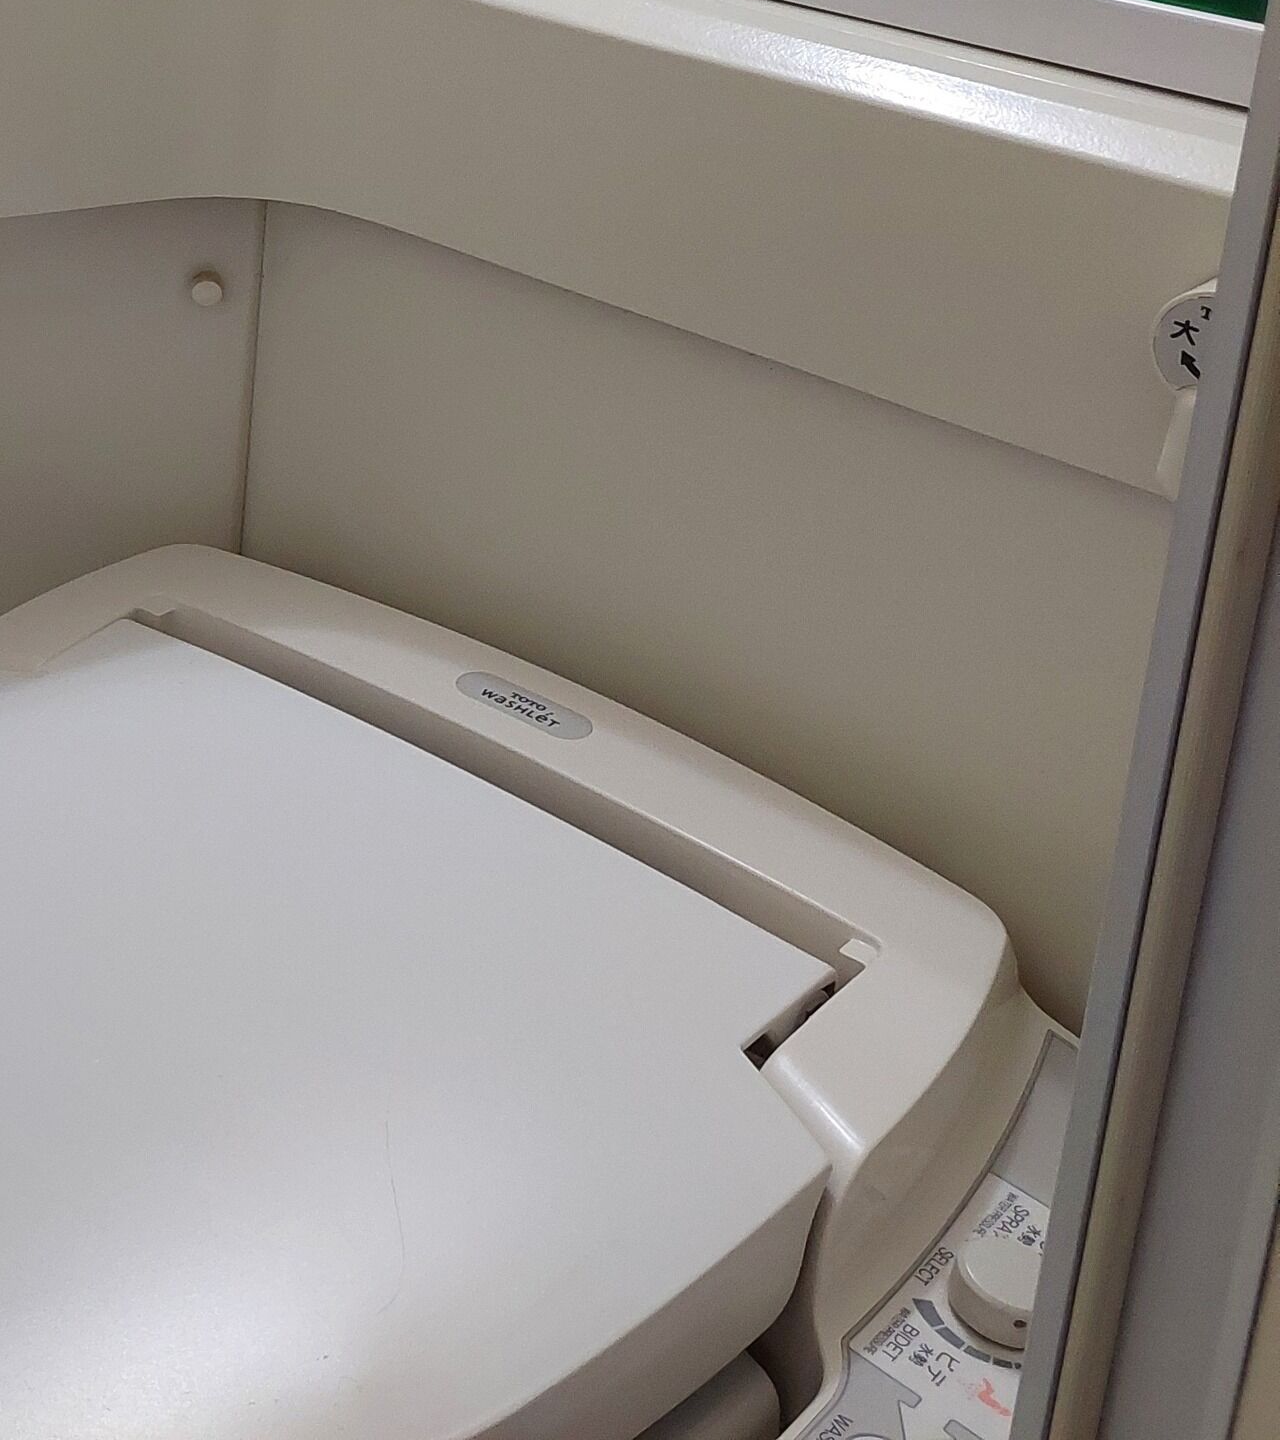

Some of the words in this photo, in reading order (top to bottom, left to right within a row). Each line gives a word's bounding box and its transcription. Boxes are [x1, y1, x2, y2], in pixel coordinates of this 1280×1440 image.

[1169, 320, 1199, 346] 大
[510, 691, 546, 711] TOTO
[914, 1246, 954, 1286] SELECT
[882, 1323, 920, 1362] BIDET
[928, 1352, 960, 1386] ビデ
[816, 1414, 853, 1440] WAS
